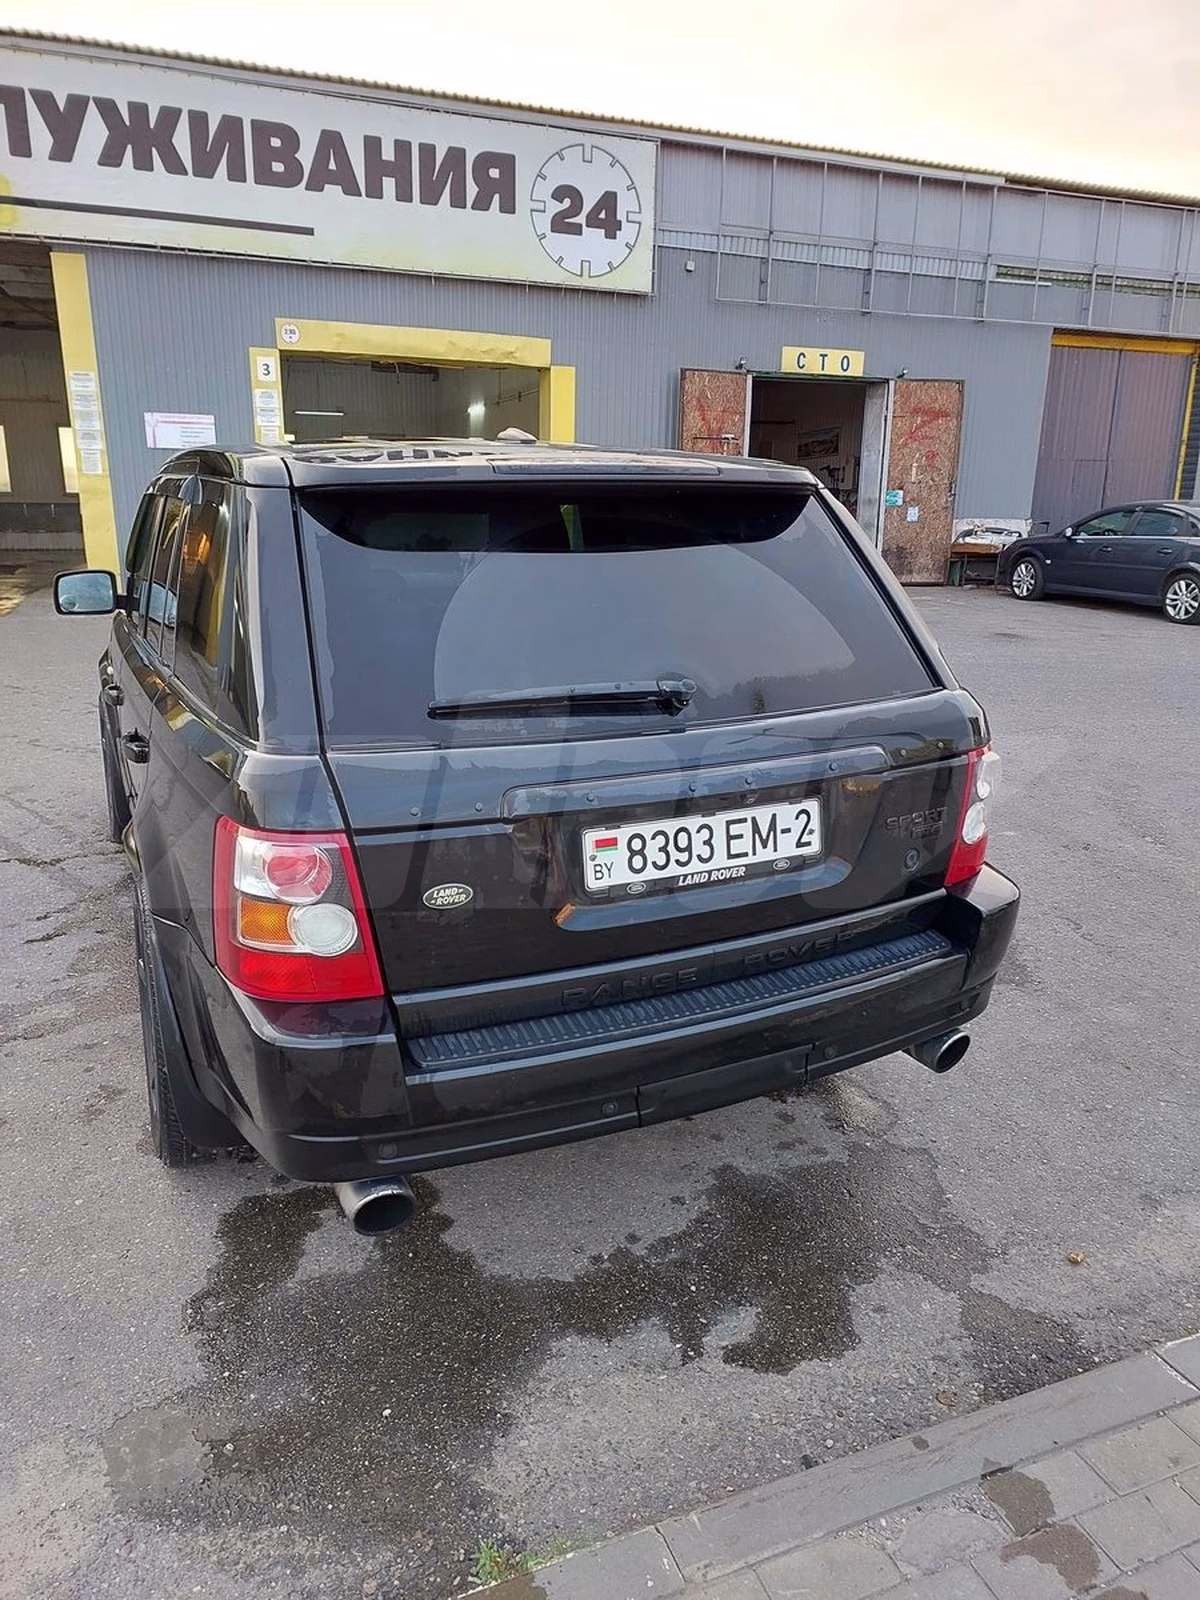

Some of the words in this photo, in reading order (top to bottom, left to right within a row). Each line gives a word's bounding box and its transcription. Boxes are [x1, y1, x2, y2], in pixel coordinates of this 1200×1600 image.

[549, 184, 622, 240] 24
[262, 363, 271, 376] 3
[796, 352, 850, 373] СТО
[886, 806, 948, 831] SPORT
[626, 823, 715, 874] 8393
[725, 808, 813, 860] EM-2
[593, 861, 615, 881] BY
[678, 870, 710, 887] LAND
[710, 866, 747, 882] ROVER
[433, 887, 458, 898] LAND
[436, 894, 466, 905] ROVER
[560, 966, 699, 1007] RANGE
[741, 931, 857, 970] ROVER
